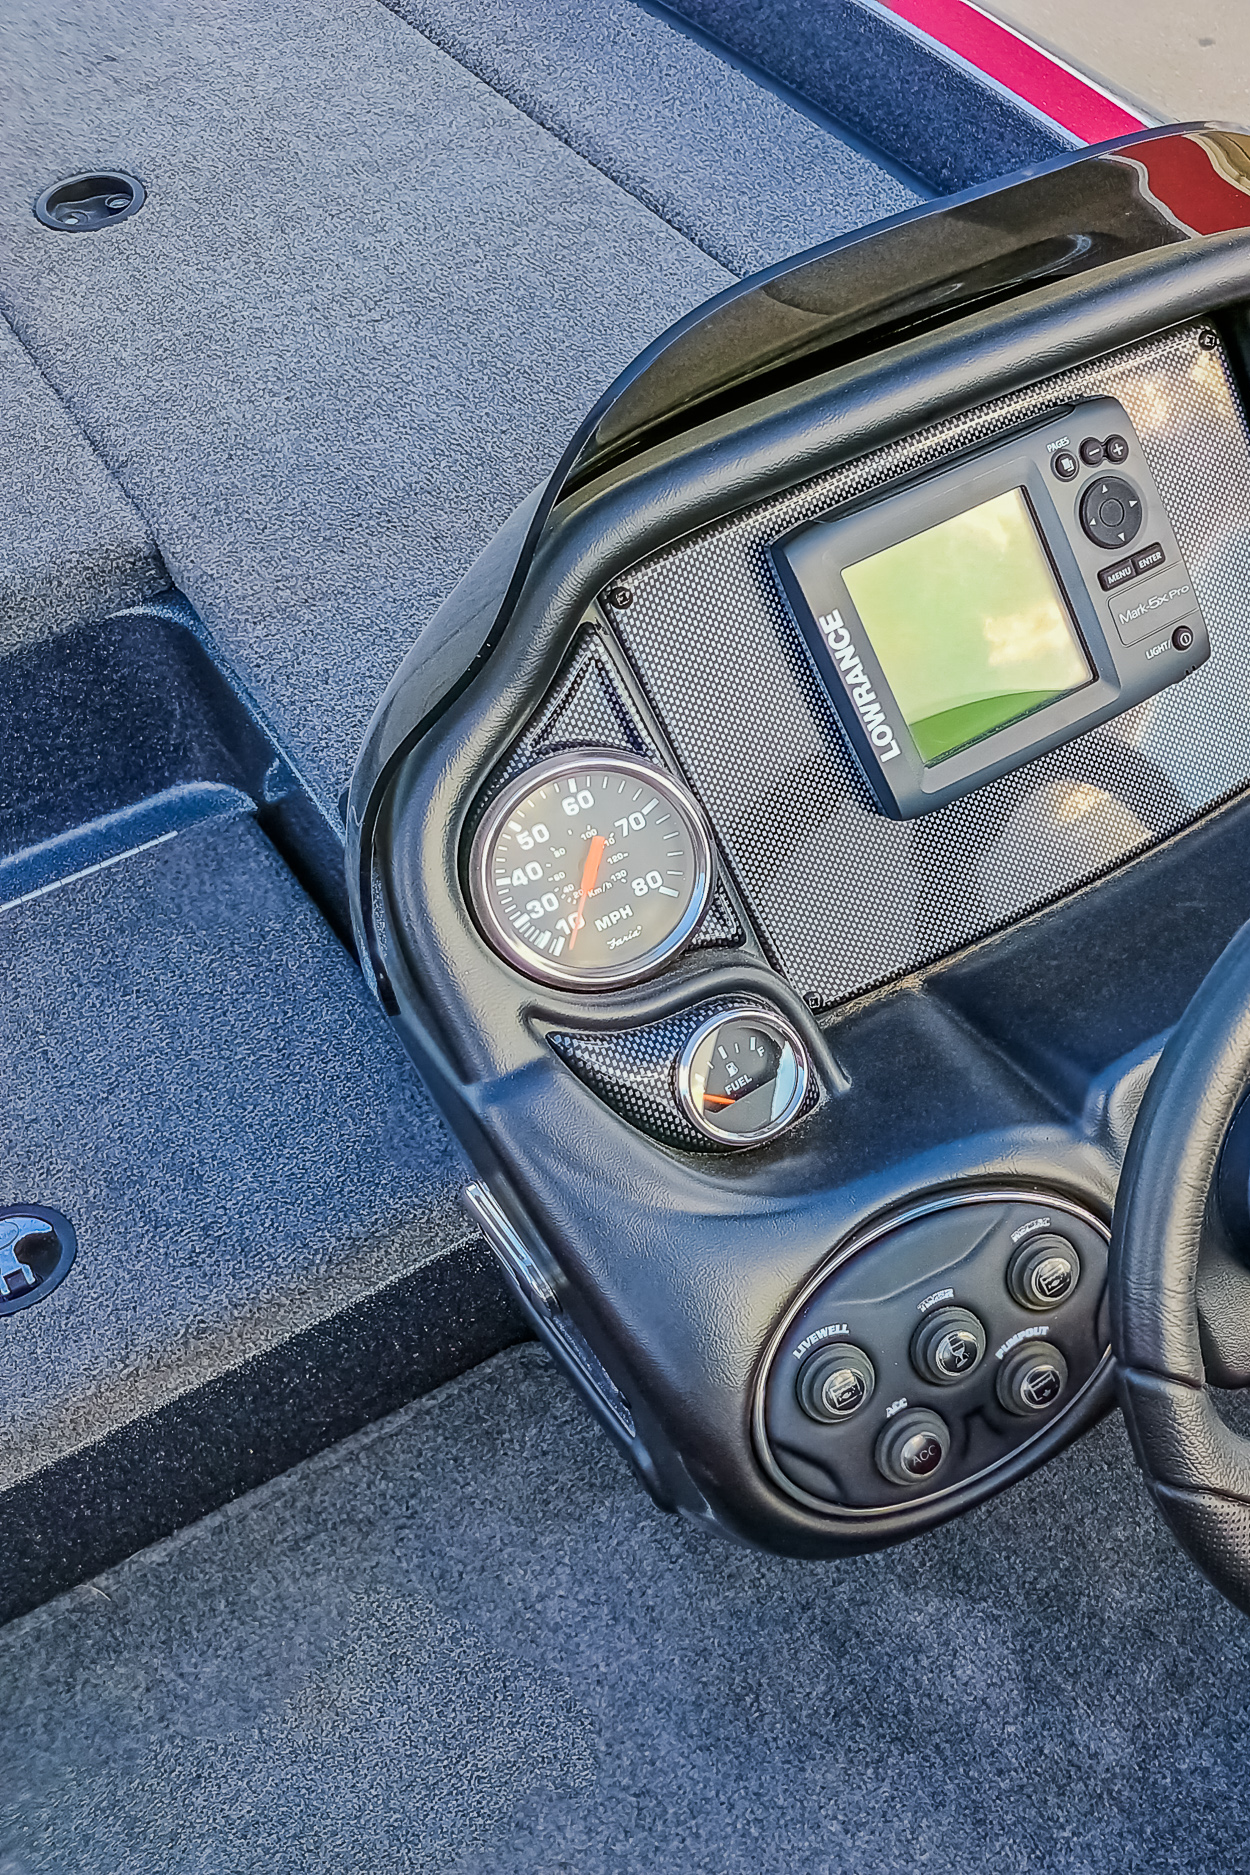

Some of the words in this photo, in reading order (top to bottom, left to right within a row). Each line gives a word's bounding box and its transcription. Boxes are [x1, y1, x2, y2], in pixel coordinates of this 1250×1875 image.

[1046, 436, 1070, 453] PAGES
[1107, 566, 1132, 584] MENU
[1138, 551, 1162, 569] ENTER
[1118, 593, 1169, 625] Mark-5x
[1168, 585, 1190, 600] Pro
[819, 608, 902, 763] LOWRANCE
[561, 789, 595, 816] 60
[516, 823, 550, 851] 50
[580, 828, 598, 841] 100
[614, 811, 646, 837] 70
[607, 852, 624, 865] 120
[511, 860, 544, 887] 40
[610, 869, 628, 883] 130
[631, 869, 663, 897] 80
[587, 881, 613, 898] Km/h
[526, 892, 560, 920] 30
[594, 904, 634, 932] MPH
[555, 912, 586, 936] 10
[757, 1046, 766, 1057] F
[724, 1074, 753, 1095] FUEL
[793, 1324, 849, 1359] LIVEWELL
[912, 1445, 936, 1466] ACC
